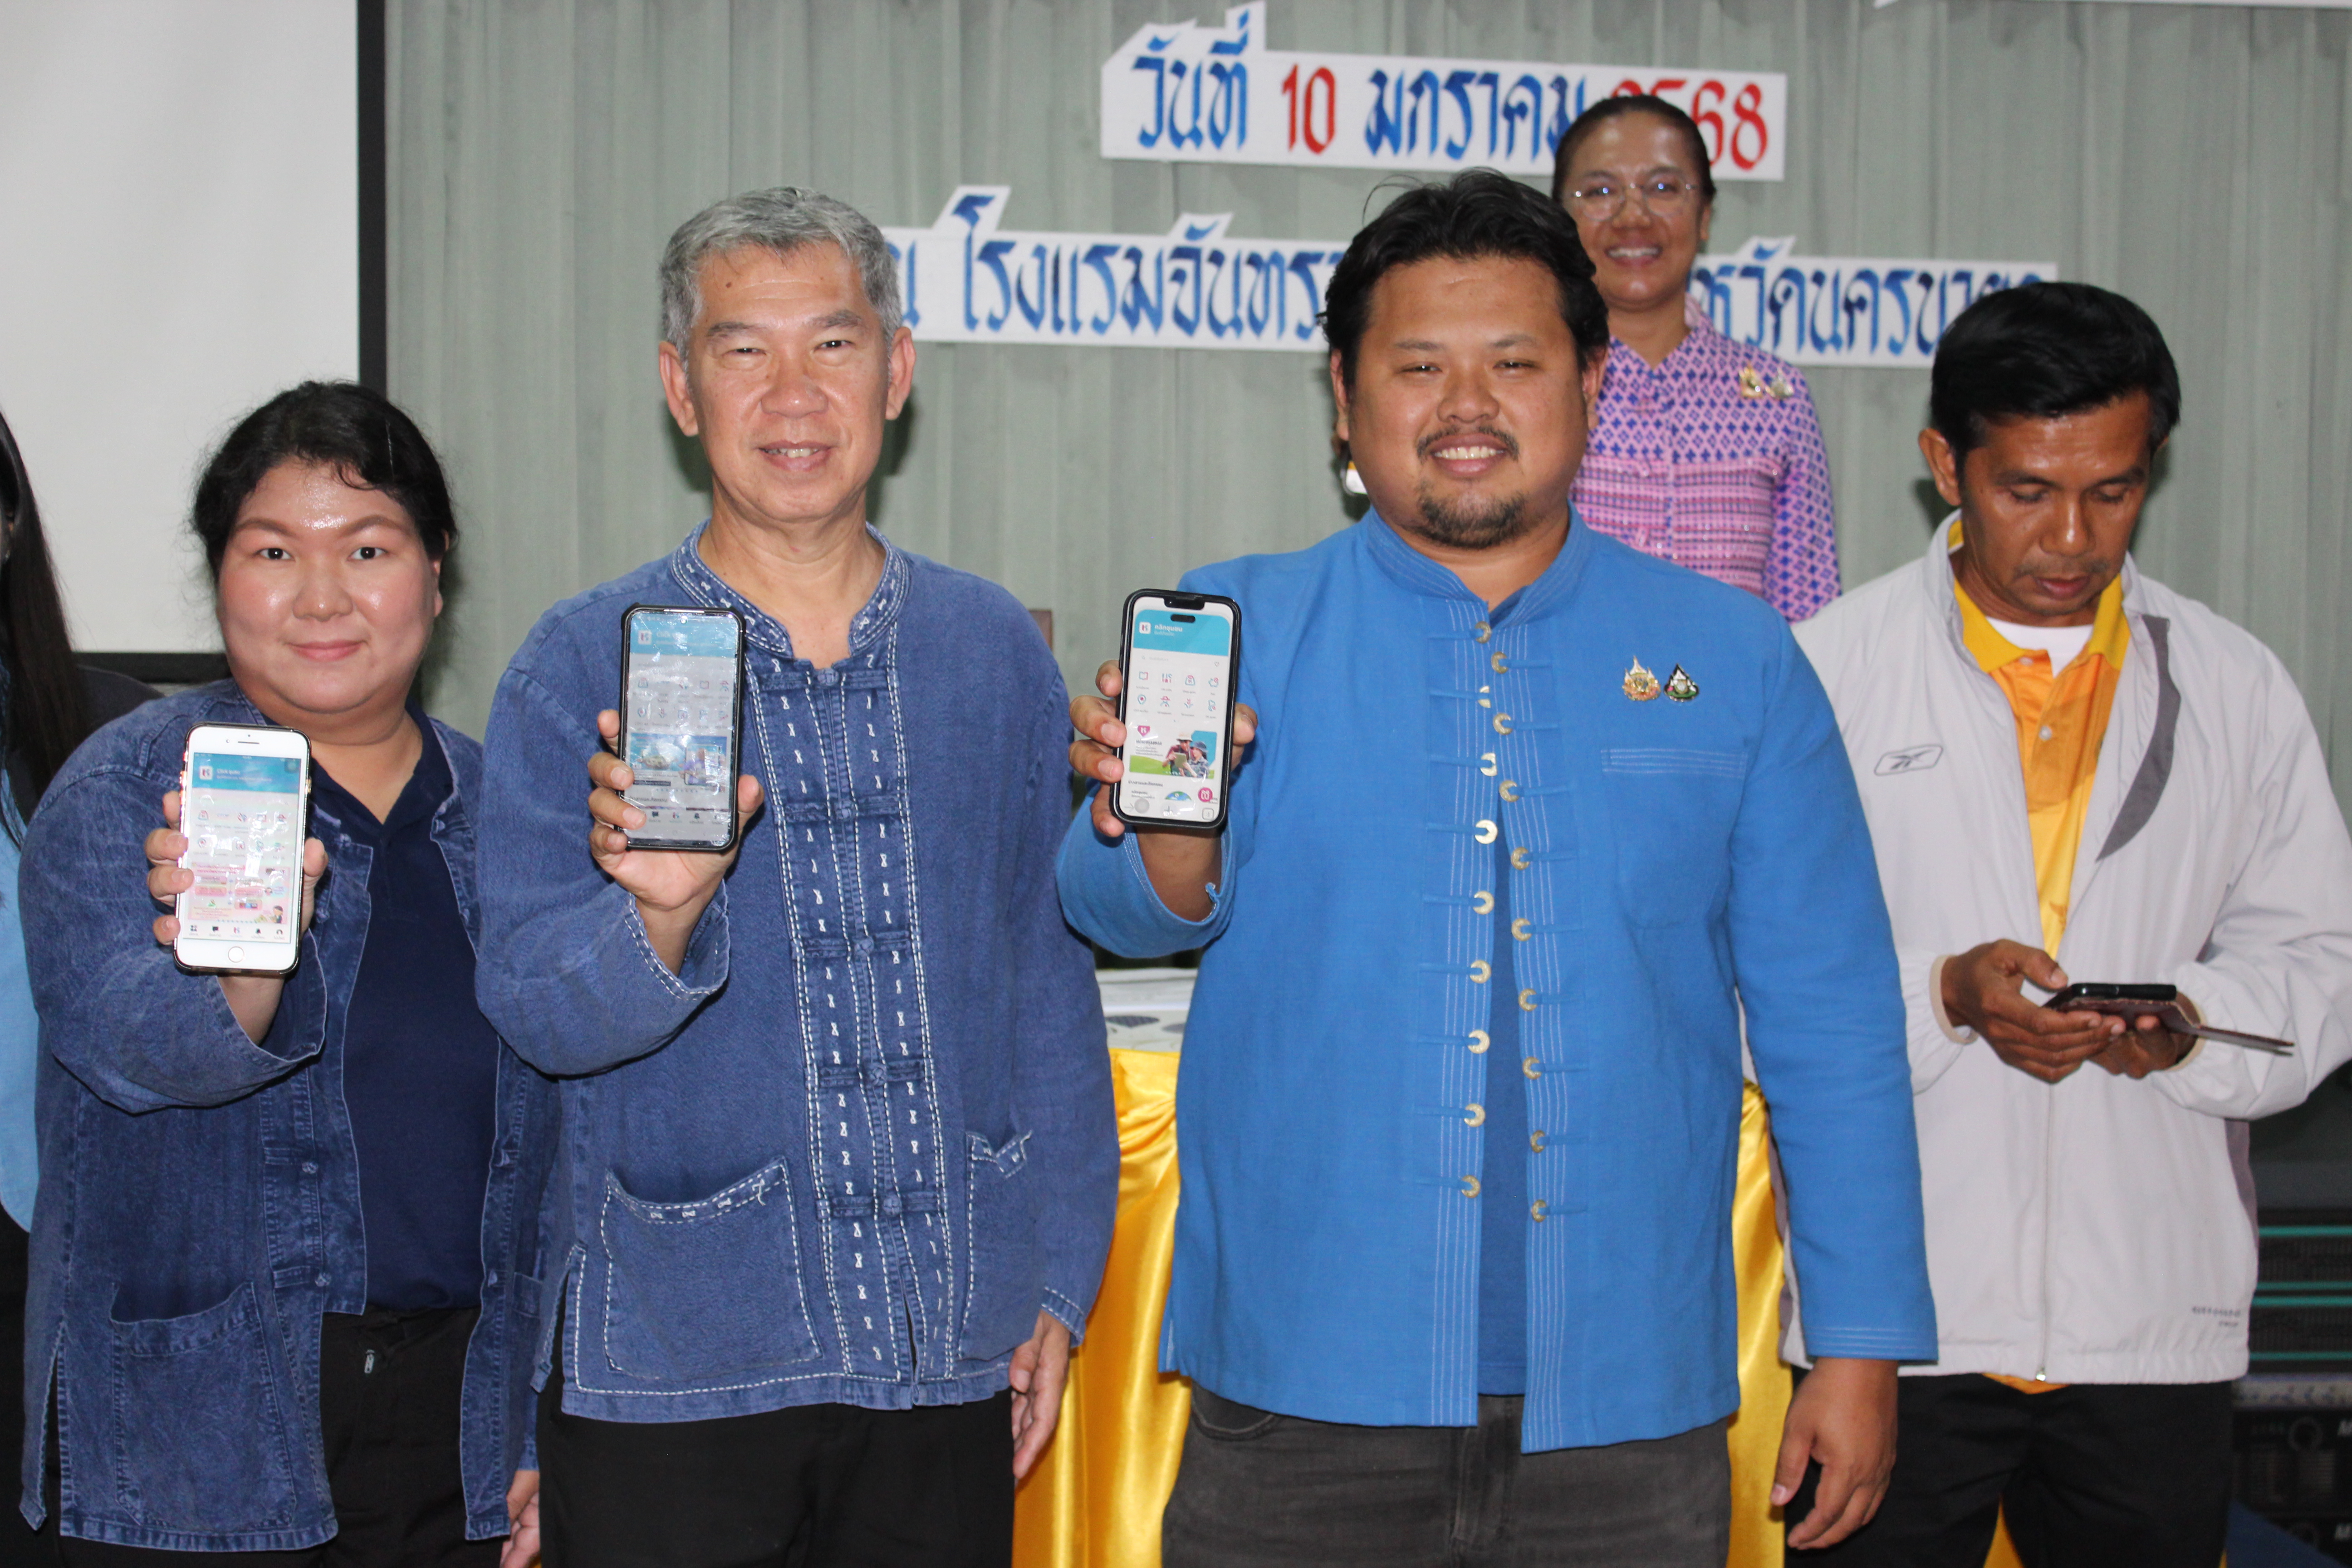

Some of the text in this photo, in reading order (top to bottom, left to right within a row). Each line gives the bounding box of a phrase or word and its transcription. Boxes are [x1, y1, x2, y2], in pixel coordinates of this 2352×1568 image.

[1133, 10, 1768, 170] วันที่ 10 มกราคม 68
[952, 194, 1347, 341] โรงแรมจันทร
